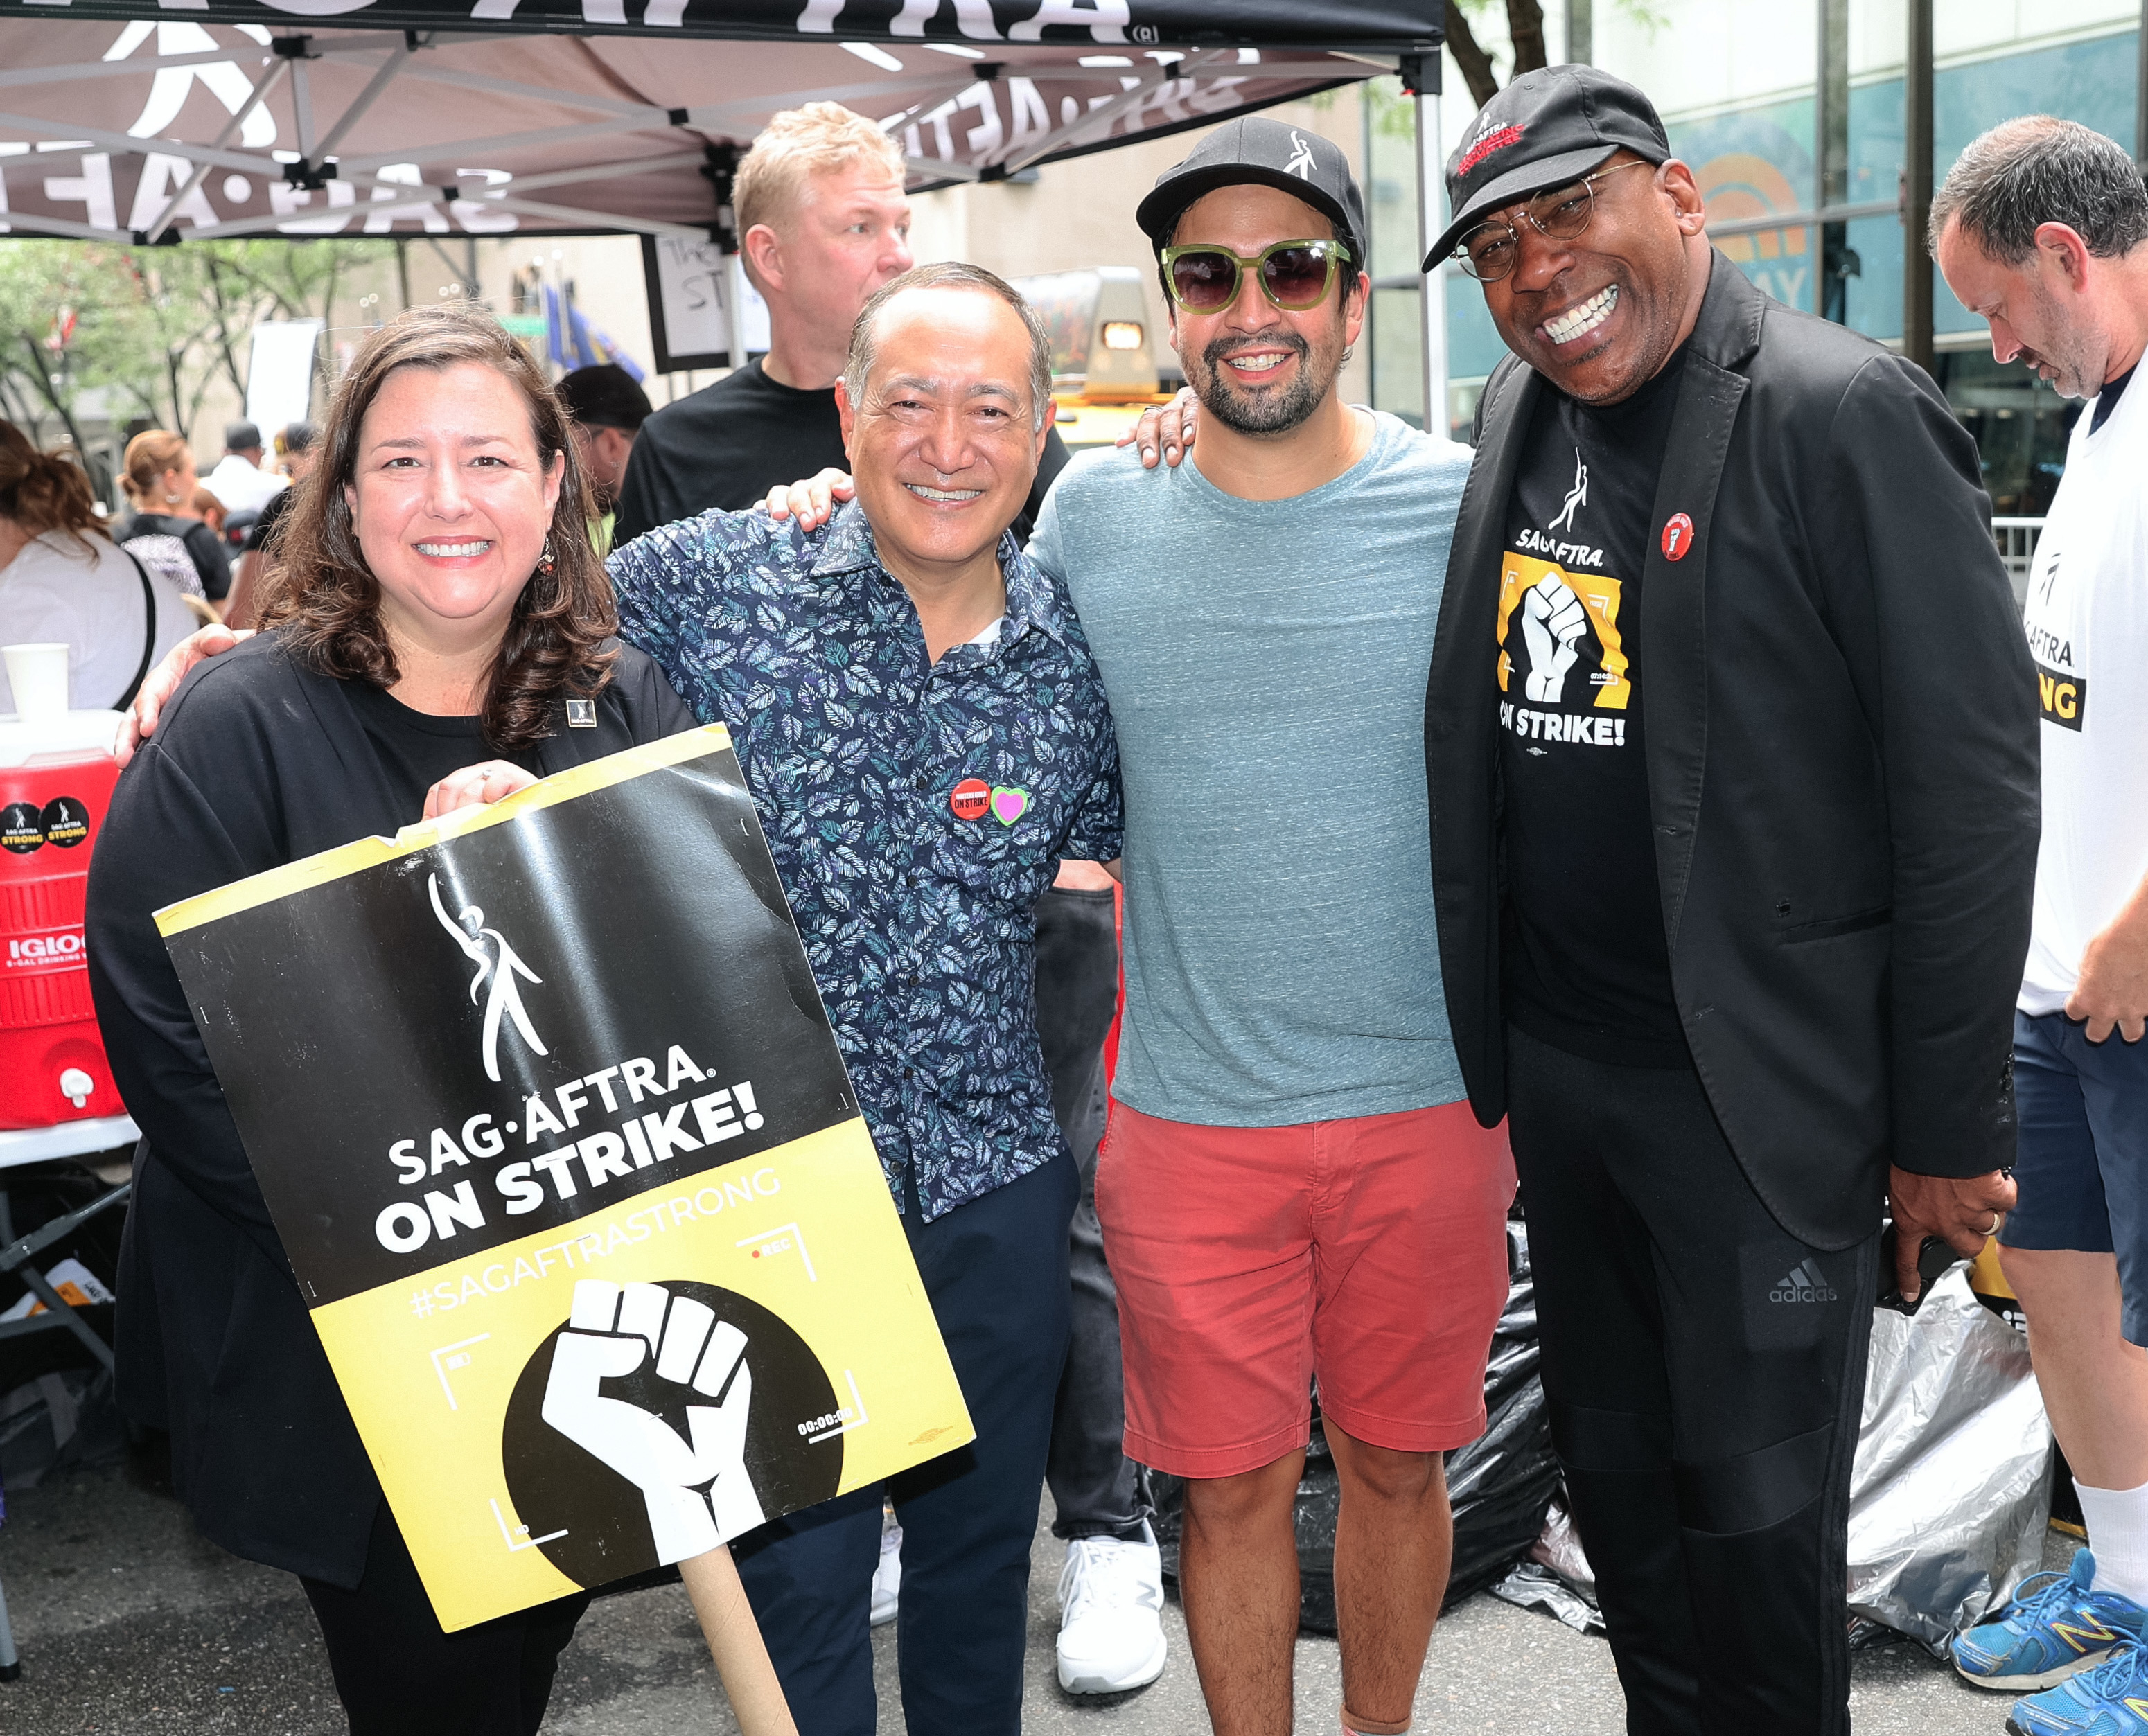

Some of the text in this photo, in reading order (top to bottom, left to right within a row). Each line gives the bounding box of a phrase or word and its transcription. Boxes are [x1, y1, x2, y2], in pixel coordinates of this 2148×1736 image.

[2039, 673, 2077, 719] NG
[1499, 700, 1626, 746] ON STRIKE!
[954, 797, 988, 809] ON STRIKE
[1, 834, 44, 845] STRONG
[48, 826, 87, 841] STRONG
[375, 1080, 764, 1254] ON STRIKE!
[409, 1167, 782, 1319] #SAGAFTRASTRONG
[761, 1238, 791, 1257] REC
[1769, 1286, 1837, 1302] adidas
[798, 1407, 854, 1436] 00:00:00
